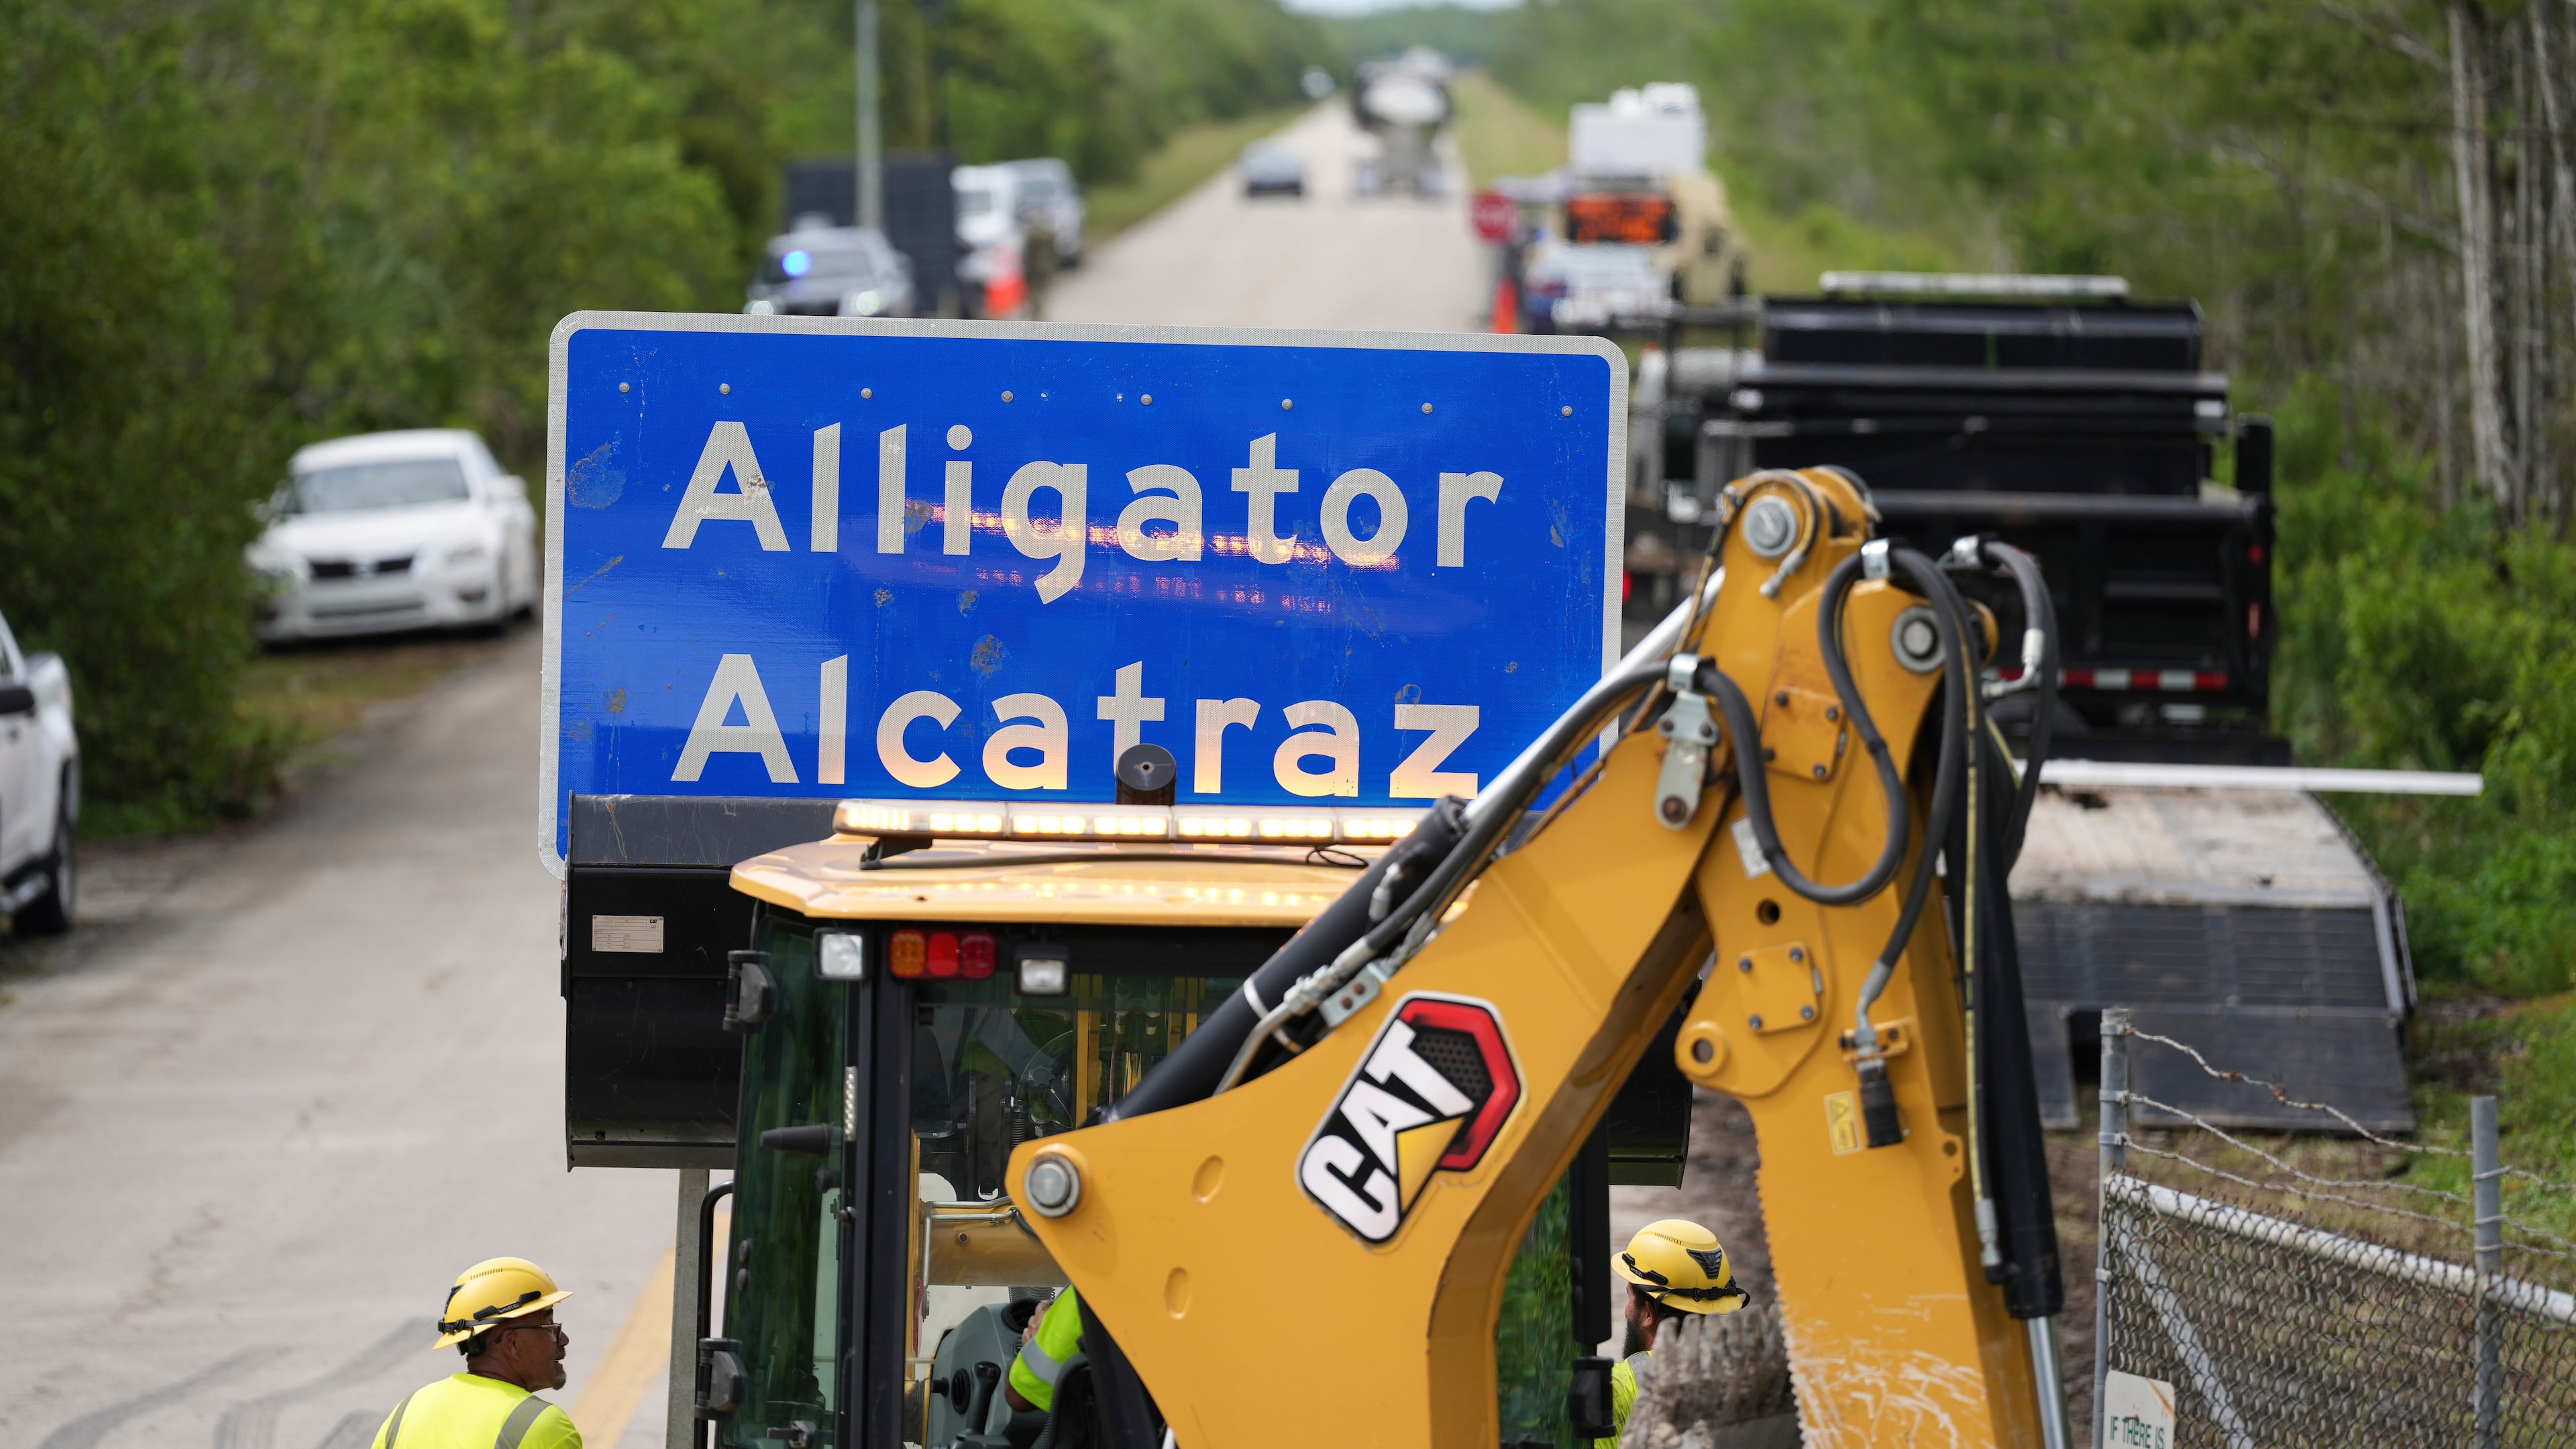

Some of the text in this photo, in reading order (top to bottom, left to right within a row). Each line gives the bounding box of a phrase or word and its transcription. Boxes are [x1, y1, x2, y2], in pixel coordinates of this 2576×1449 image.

[661, 421, 1504, 604] Alligator
[671, 653, 1480, 799] Alcatraz
[1301, 1018, 1475, 1240] CAT
[2110, 1417, 2165, 1449] IF THERE IS
